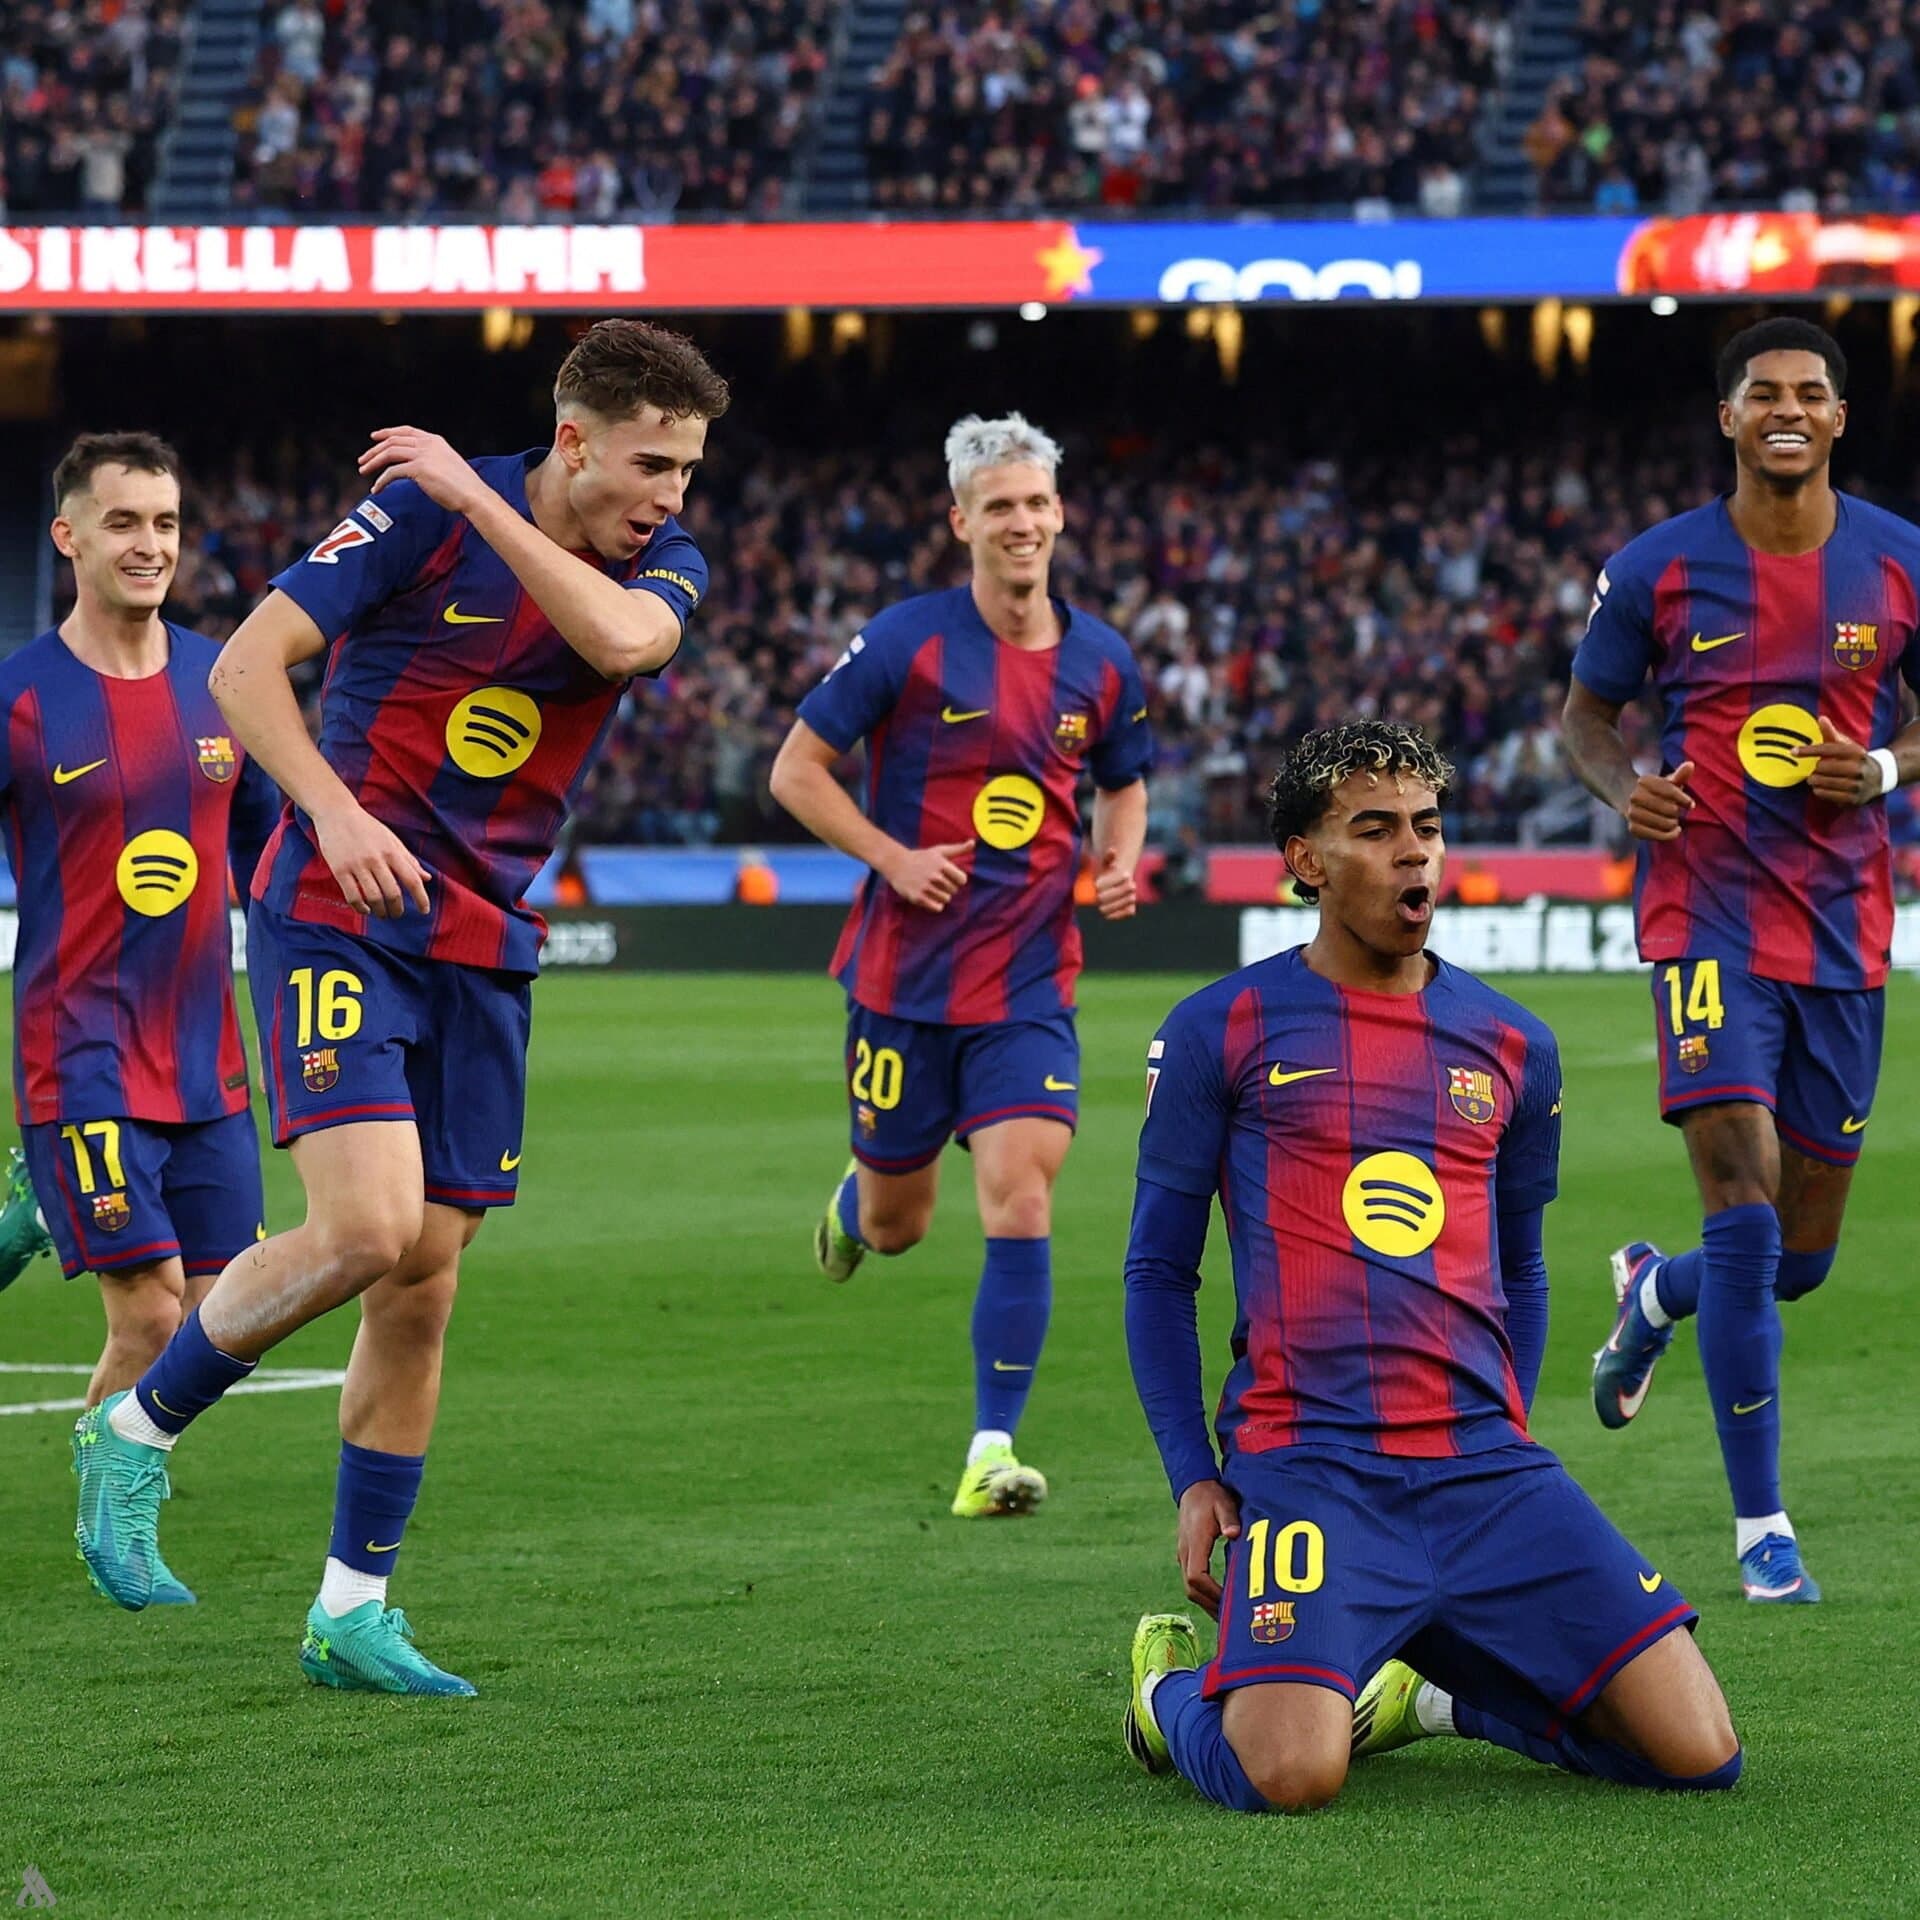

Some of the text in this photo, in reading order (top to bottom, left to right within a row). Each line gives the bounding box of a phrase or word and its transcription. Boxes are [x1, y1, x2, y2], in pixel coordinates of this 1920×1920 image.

[288, 967, 364, 1047] 16
[1664, 959, 1725, 1036] 14
[852, 1038, 904, 1110] 20
[61, 1120, 127, 1194] 17
[1246, 1519, 1325, 1599] 10
